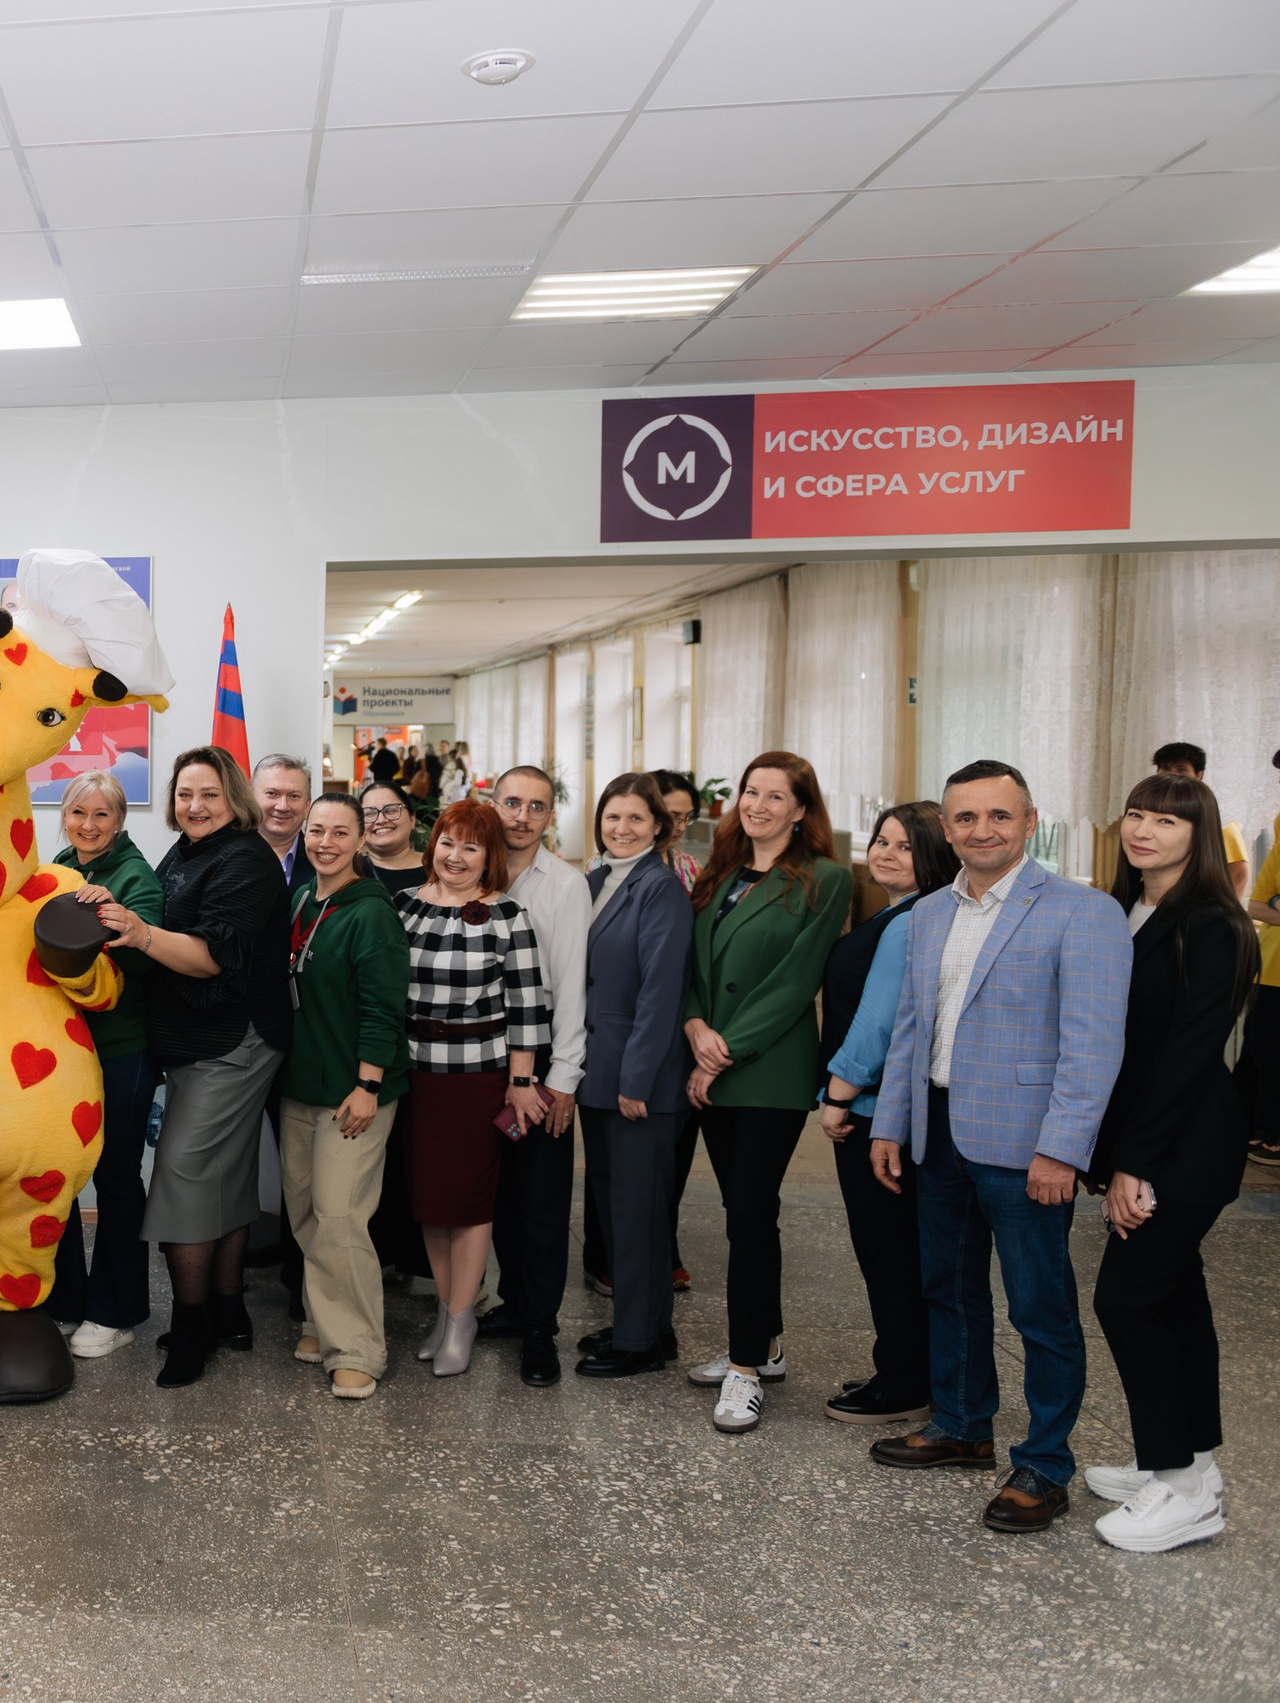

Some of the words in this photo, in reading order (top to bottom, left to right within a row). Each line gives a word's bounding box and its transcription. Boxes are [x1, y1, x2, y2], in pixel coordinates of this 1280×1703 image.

[764, 425, 970, 453] ИСКУССТВО,
[977, 416, 1124, 449] ДИЗАЙН
[657, 451, 696, 484] М
[763, 477, 786, 499] И
[795, 472, 908, 498] СФЕРА
[918, 469, 1026, 495] УСЛУГ
[363, 687, 451, 697] Национальные
[363, 698, 413, 709] проекты
